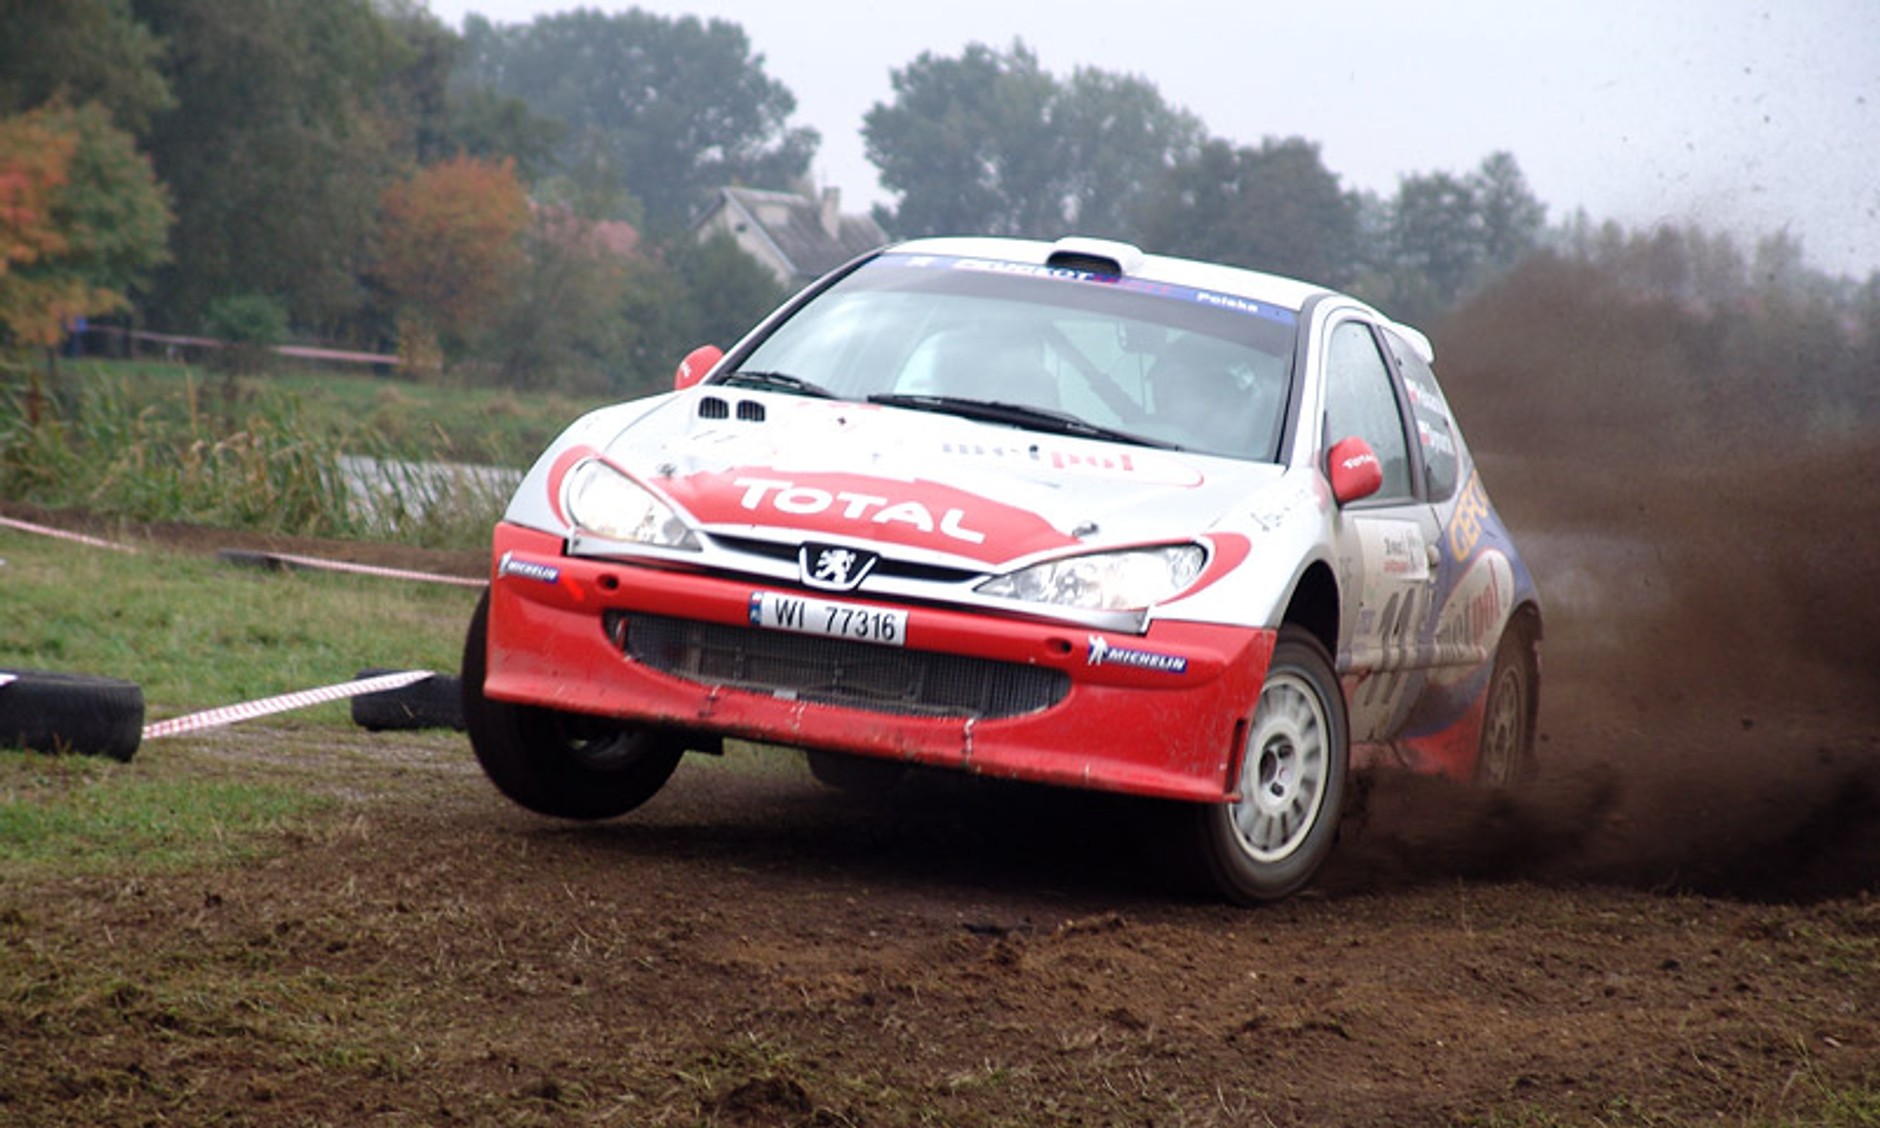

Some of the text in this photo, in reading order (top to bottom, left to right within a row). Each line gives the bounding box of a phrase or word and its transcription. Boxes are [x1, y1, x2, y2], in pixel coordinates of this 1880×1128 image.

[1197, 291, 1258, 312] Polska
[733, 477, 985, 544] TOTAL
[508, 560, 558, 580] MICHELIN
[775, 598, 896, 640] WI 77316
[1108, 647, 1187, 671] MICHELIN
